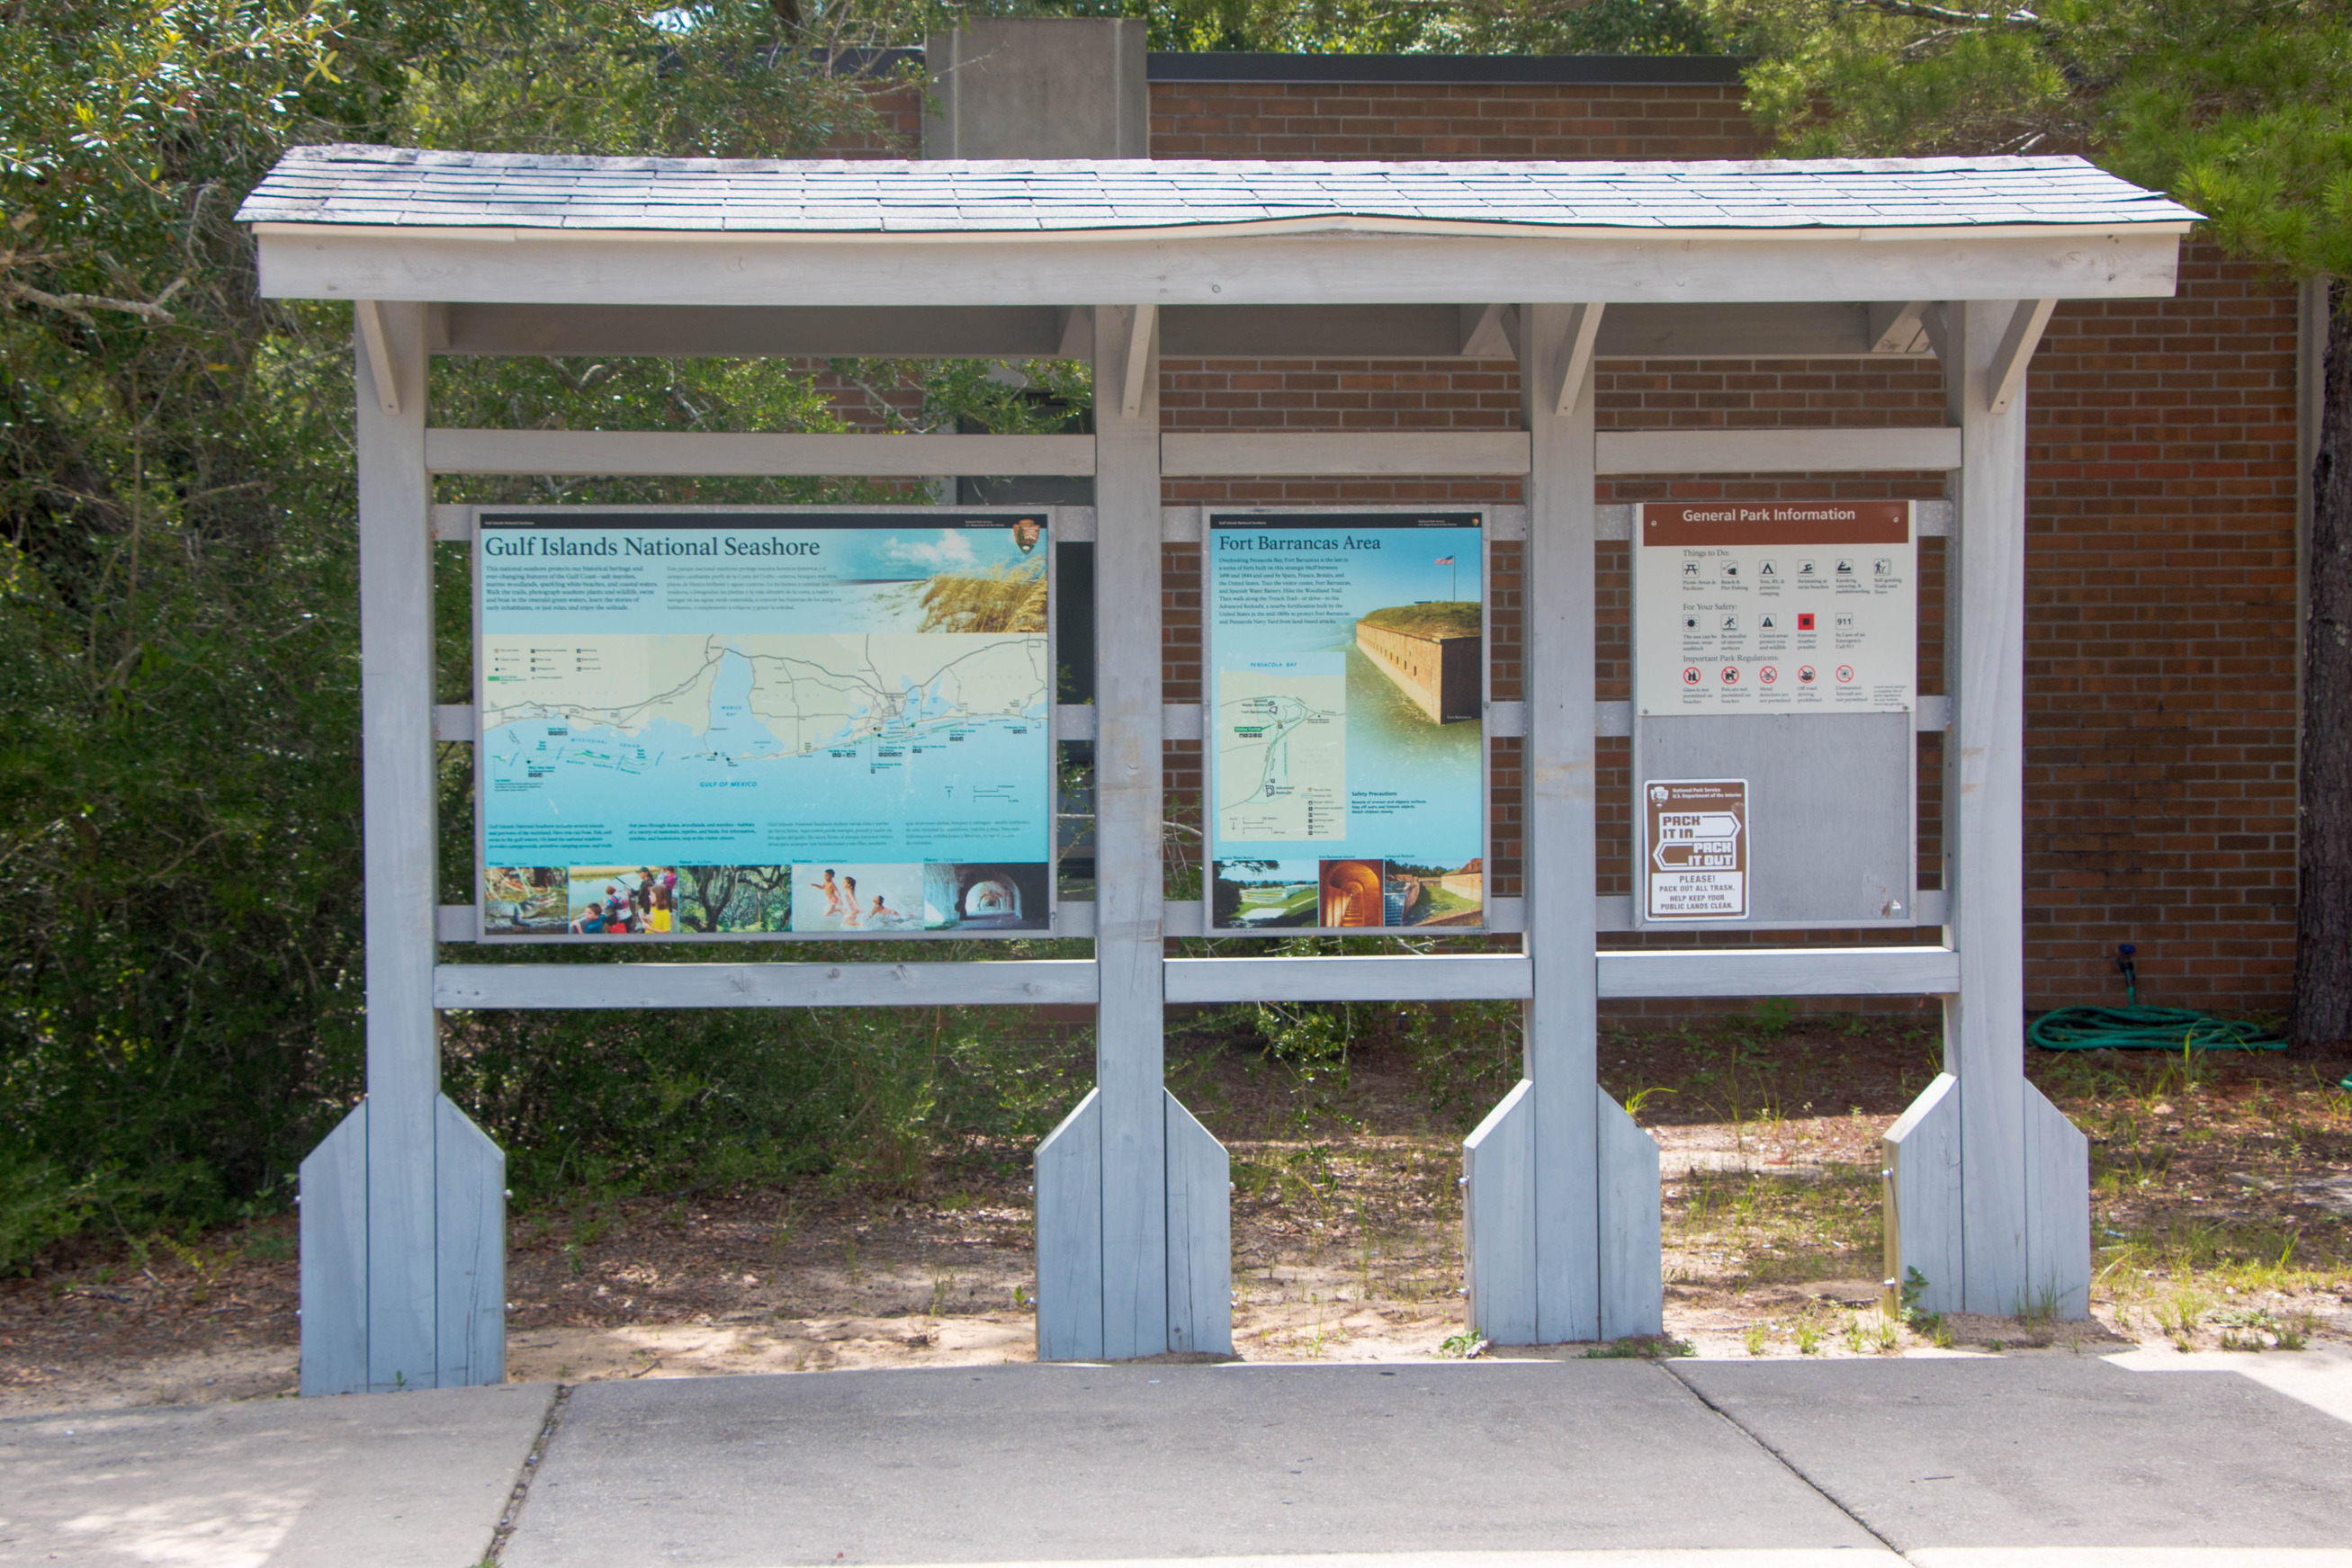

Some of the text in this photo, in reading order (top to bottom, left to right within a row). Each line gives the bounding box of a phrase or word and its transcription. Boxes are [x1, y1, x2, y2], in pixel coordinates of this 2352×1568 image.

[1683, 509, 1855, 522] General Park Information
[485, 537, 820, 556] Gulf Islands National Seashore
[1219, 536, 1381, 550] Fort Barrancas Area
[1683, 550, 1706, 558] Things
[1737, 655, 1779, 663] Regulations:
[1663, 816, 1700, 826] PACK
[1663, 829, 1693, 838] IT IN
[1693, 842, 1732, 853] PACK
[1688, 856, 1732, 866] IT OUT
